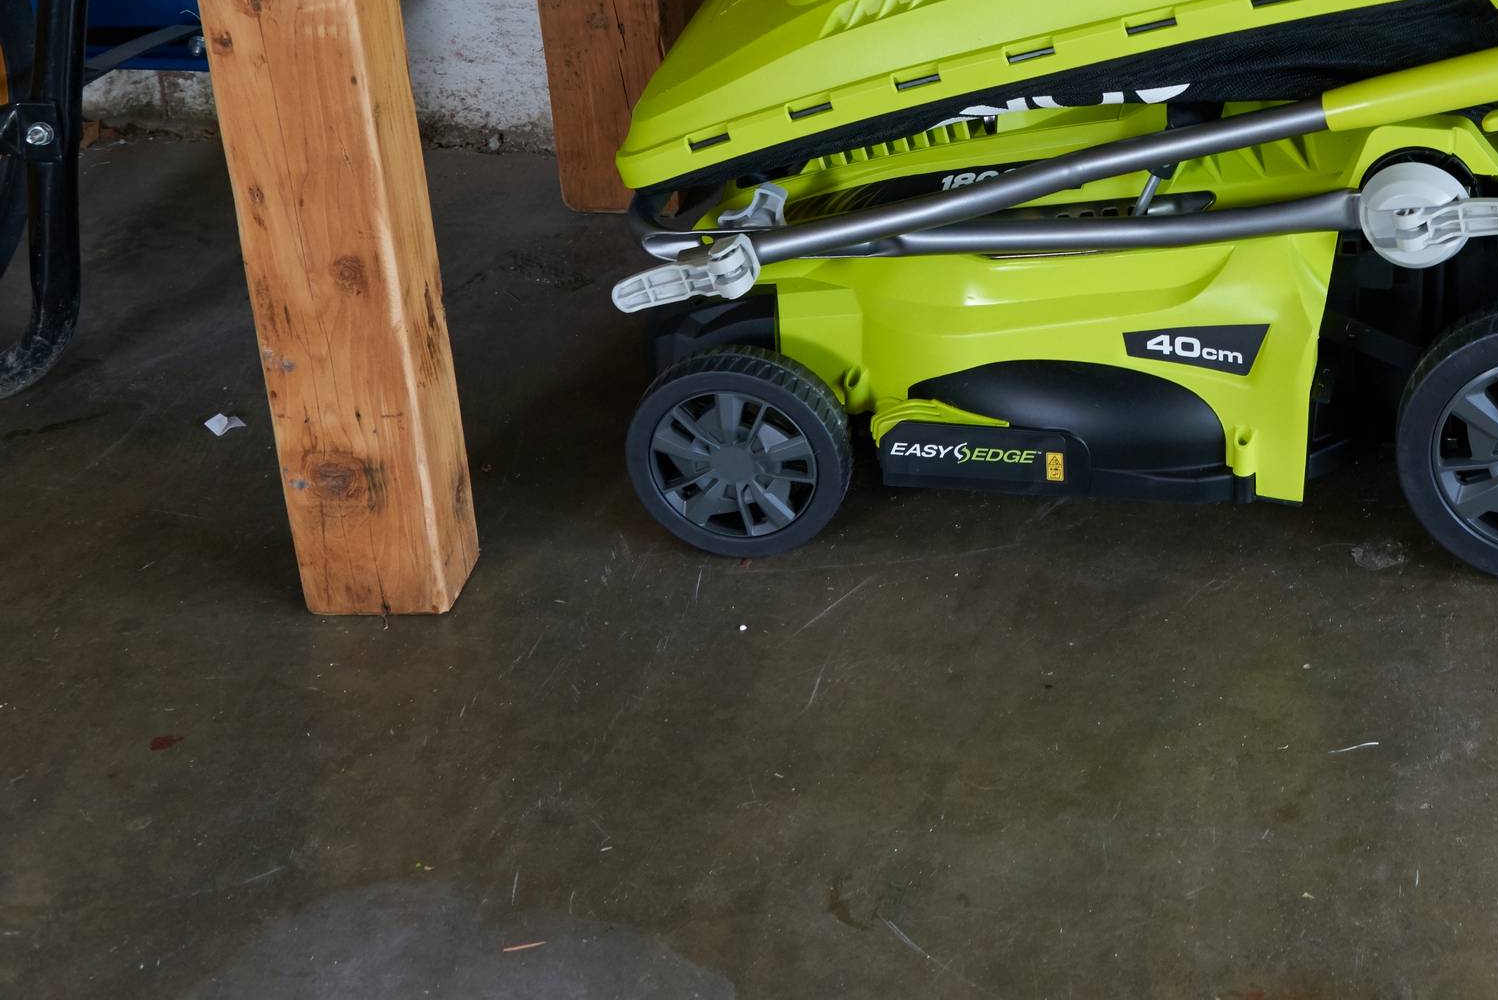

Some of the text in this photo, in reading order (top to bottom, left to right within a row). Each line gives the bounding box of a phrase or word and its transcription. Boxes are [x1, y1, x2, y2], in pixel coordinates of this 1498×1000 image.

[1146, 334, 1243, 364] 40cm
[890, 442, 1037, 464] EASY EDGE
